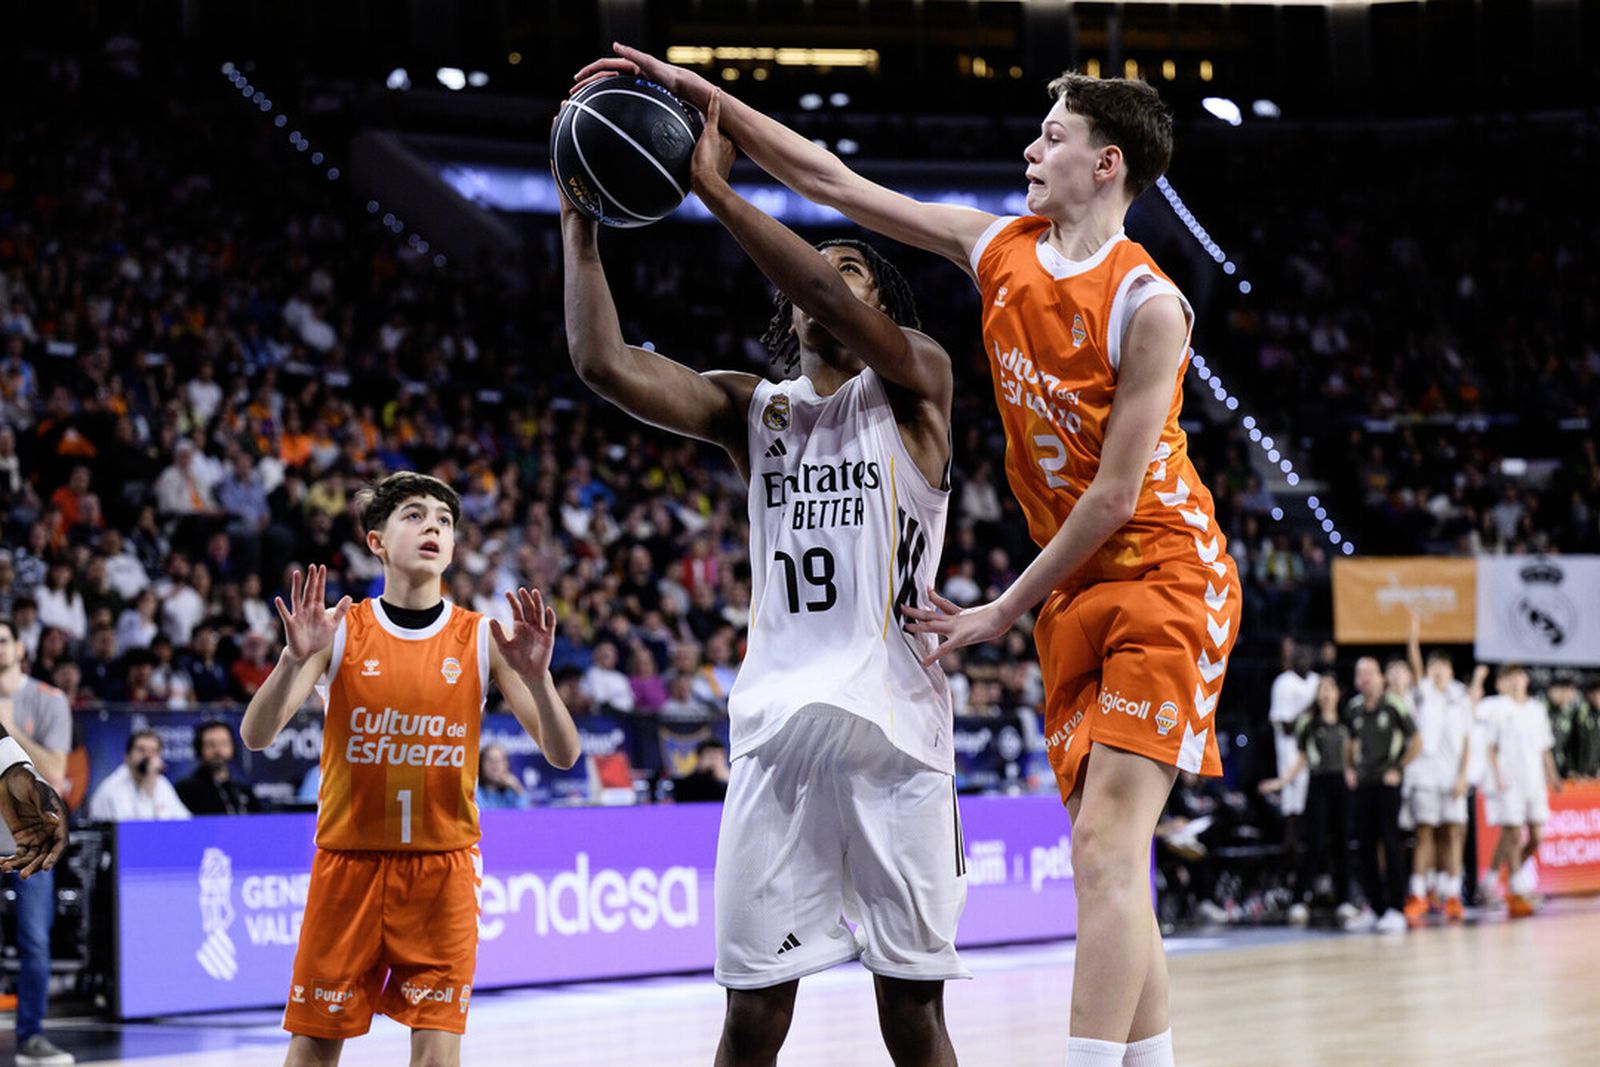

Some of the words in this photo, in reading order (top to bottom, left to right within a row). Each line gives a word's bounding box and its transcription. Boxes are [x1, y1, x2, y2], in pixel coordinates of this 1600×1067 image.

[1056, 387, 1081, 406] del
[1033, 434, 1070, 489] 2
[762, 458, 880, 508] Emrates
[792, 497, 864, 530] BETTER
[774, 547, 838, 614] 19
[350, 706, 446, 737] Cultura
[447, 722, 467, 738] del
[1098, 687, 1151, 720] igicoll
[346, 735, 466, 768] Esfuerzo
[397, 789, 412, 844] 1
[478, 851, 699, 941] endesa
